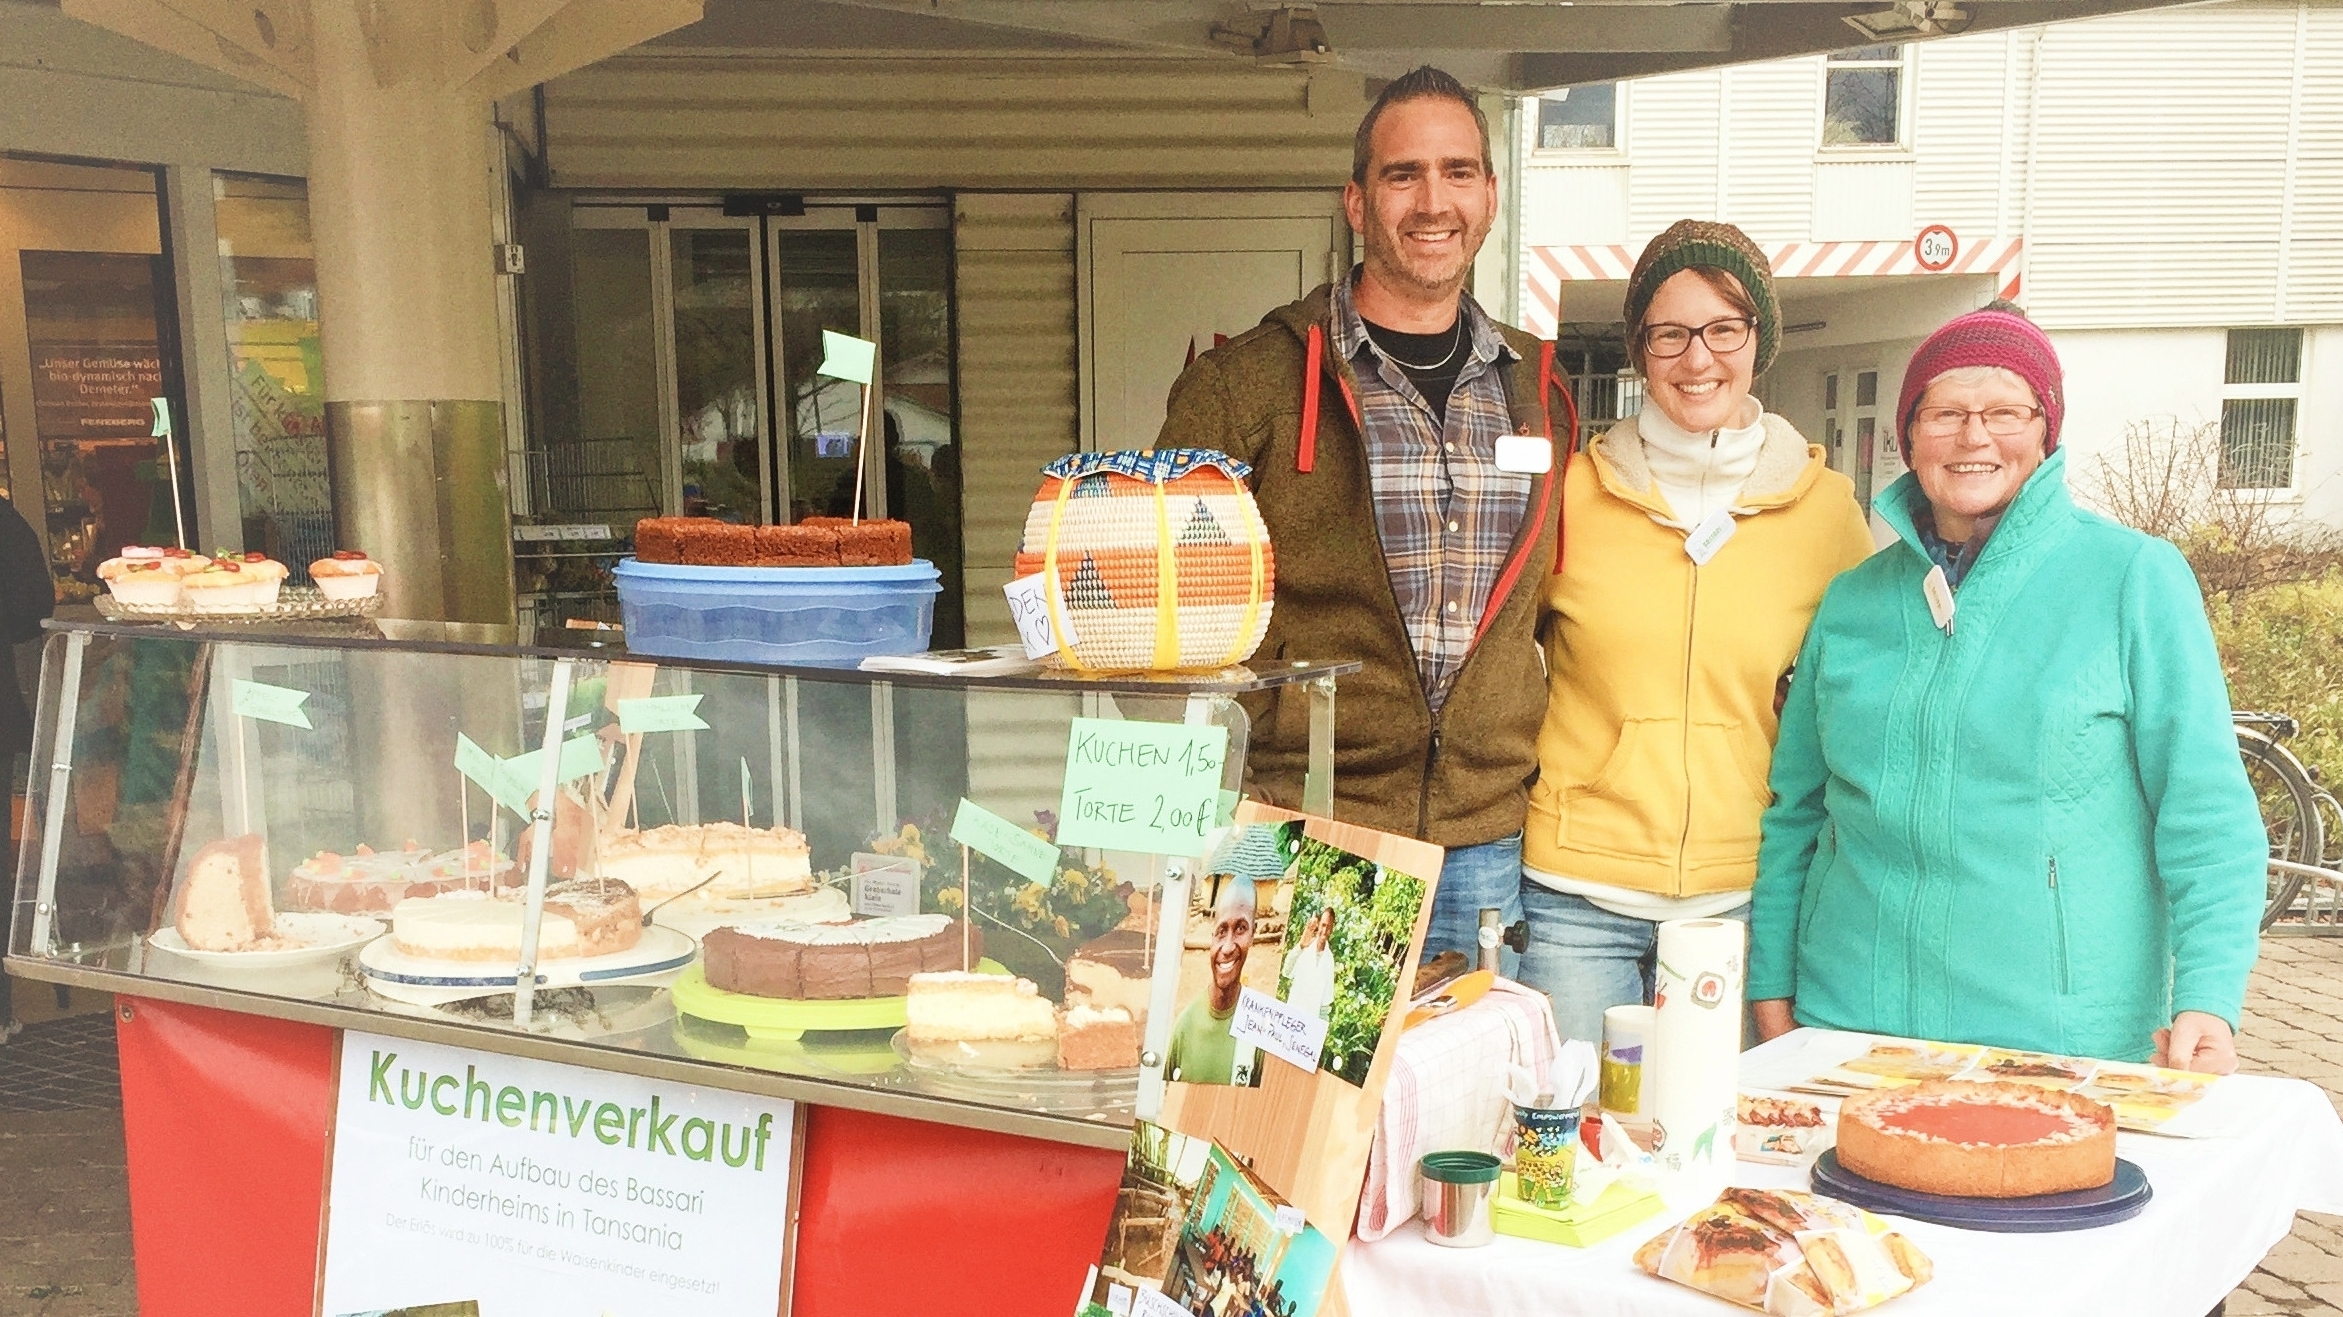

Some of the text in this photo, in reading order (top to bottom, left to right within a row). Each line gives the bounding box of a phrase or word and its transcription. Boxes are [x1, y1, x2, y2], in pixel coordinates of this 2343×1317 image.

[1075, 730, 1172, 768] KUCHEN
[1073, 786, 1137, 824] TORTE
[369, 1050, 774, 1172] Kuchenverkauf
[408, 1136, 705, 1215] für den Aufbau des Bassari
[420, 1177, 683, 1251] Kinderheims in Tansania
[386, 1212, 407, 1229] Der
[440, 1228, 464, 1241] wird
[467, 1232, 481, 1245] zu
[485, 1233, 514, 1253] 100%
[536, 1245, 557, 1261] die
[560, 1248, 647, 1279] Waisenkinder
[649, 1270, 721, 1295] eingesetzt!
